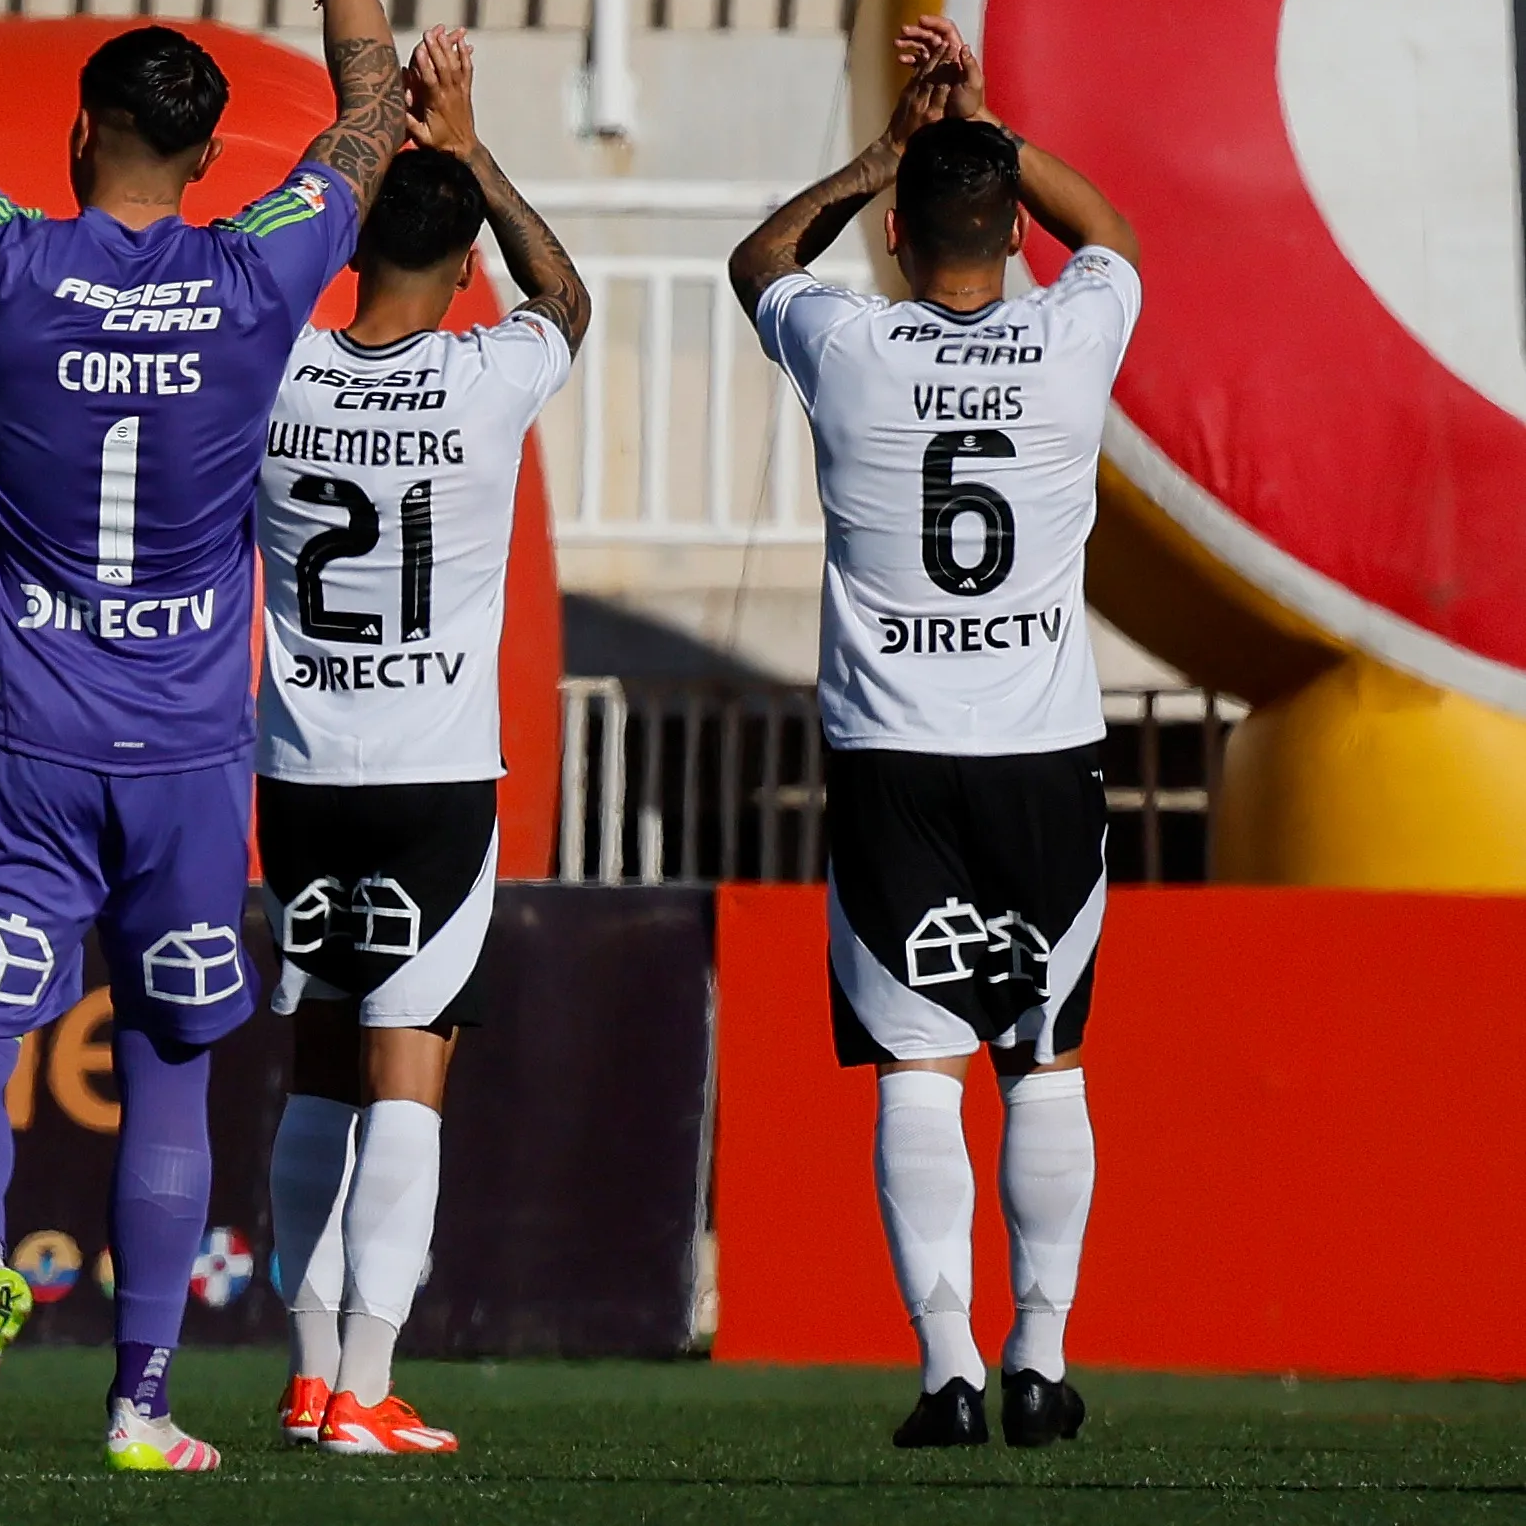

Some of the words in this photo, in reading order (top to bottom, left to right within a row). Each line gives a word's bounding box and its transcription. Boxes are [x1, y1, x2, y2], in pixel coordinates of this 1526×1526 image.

[53, 276, 213, 311] ASSIST
[101, 305, 222, 333] CARD
[57, 349, 203, 396] CORTES
[934, 343, 1044, 366] CARD
[333, 389, 447, 412] CARD
[913, 383, 1024, 422] VEGAS
[266, 418, 465, 468] WIEMBERG
[95, 414, 140, 587] 1
[921, 428, 1018, 597] 6
[288, 473, 435, 646] 21
[16, 581, 216, 640] DIRECTV
[878, 606, 1063, 655] DIRECTV
[283, 650, 467, 693] DIRECTV
